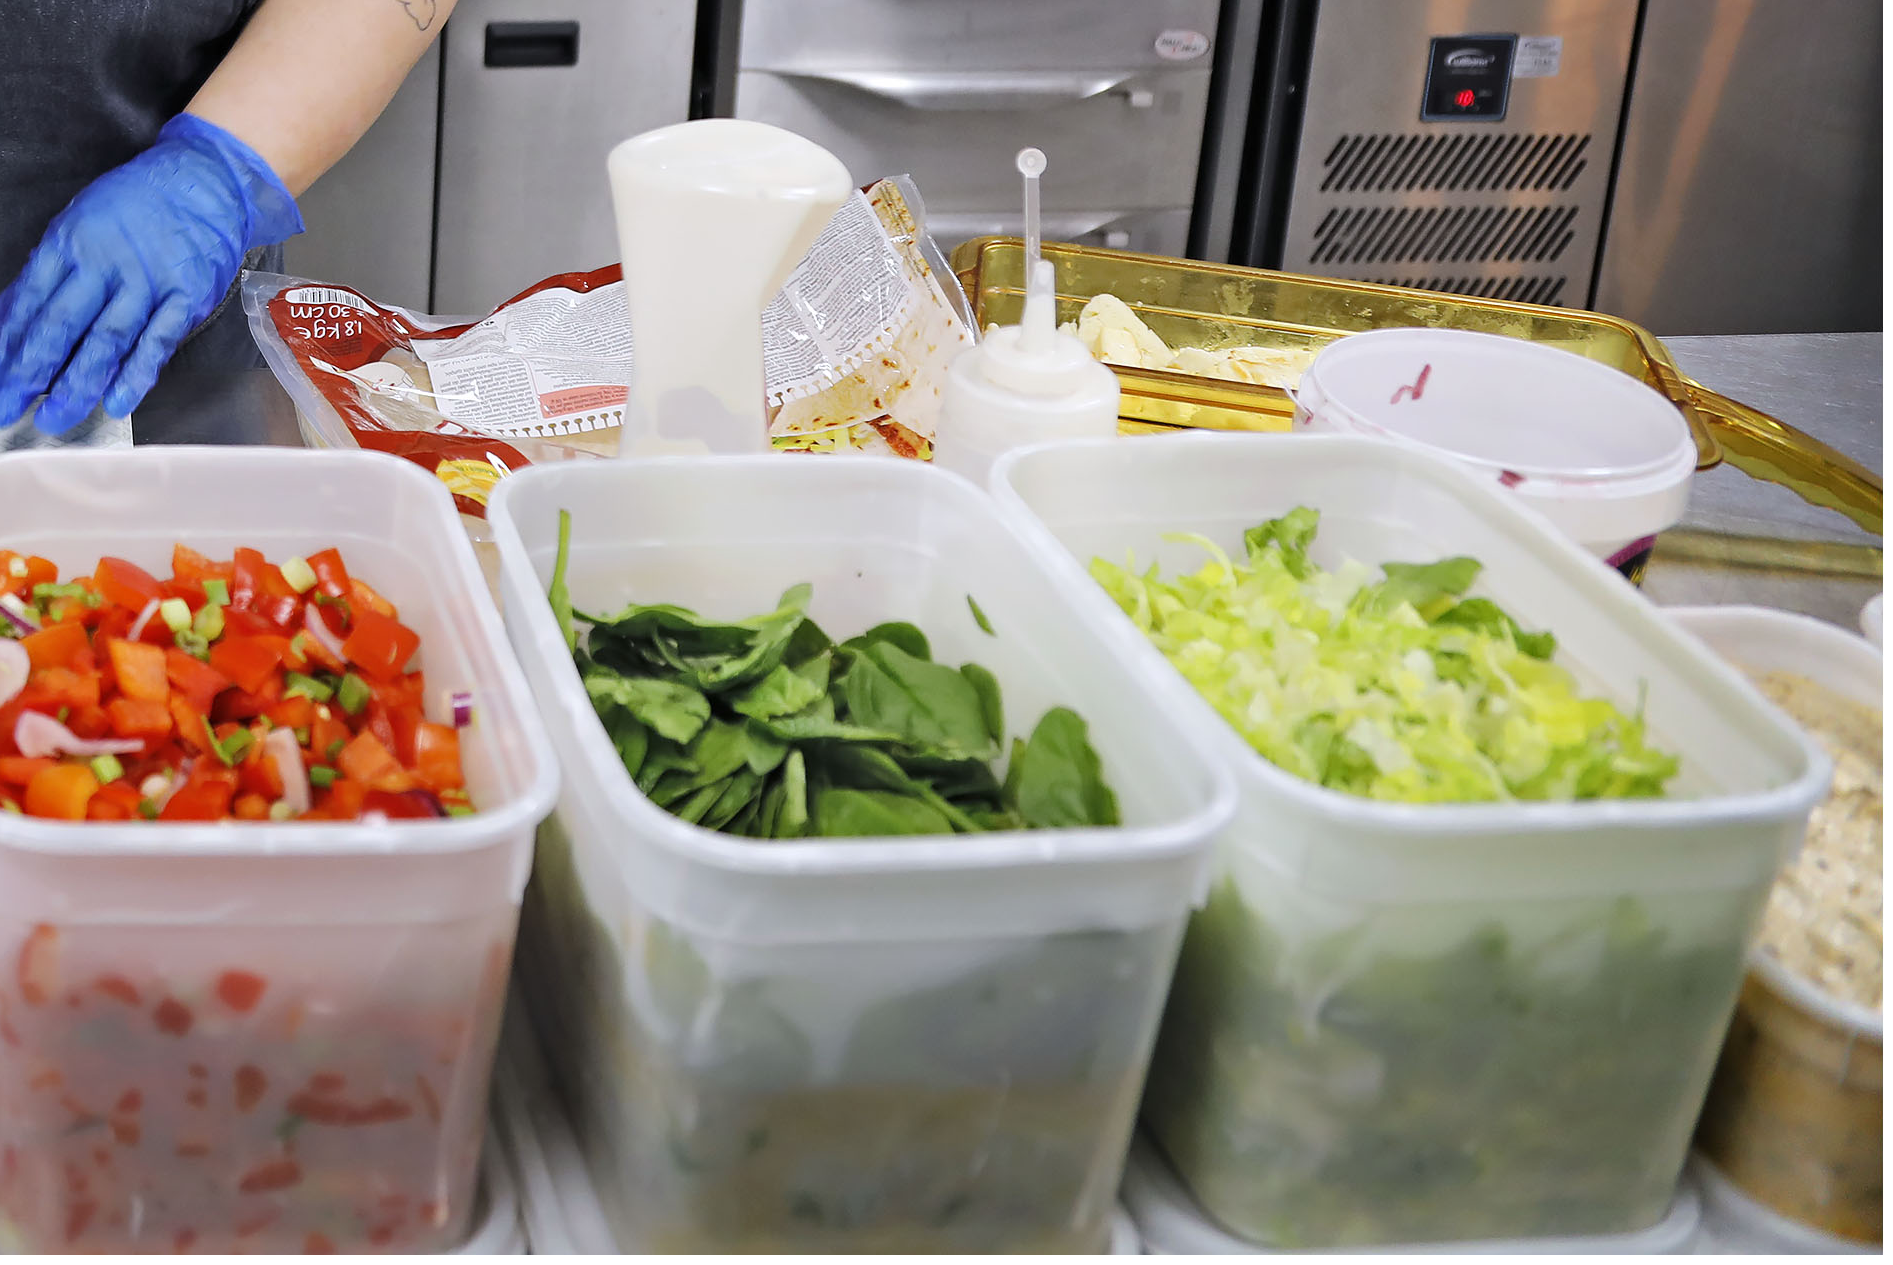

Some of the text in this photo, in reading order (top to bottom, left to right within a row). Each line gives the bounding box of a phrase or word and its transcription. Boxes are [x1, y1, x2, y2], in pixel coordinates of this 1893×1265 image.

[290, 304, 325, 319] cm
[328, 304, 351, 319] 30
[312, 318, 341, 340] kg
[344, 320, 363, 337] 1.8
